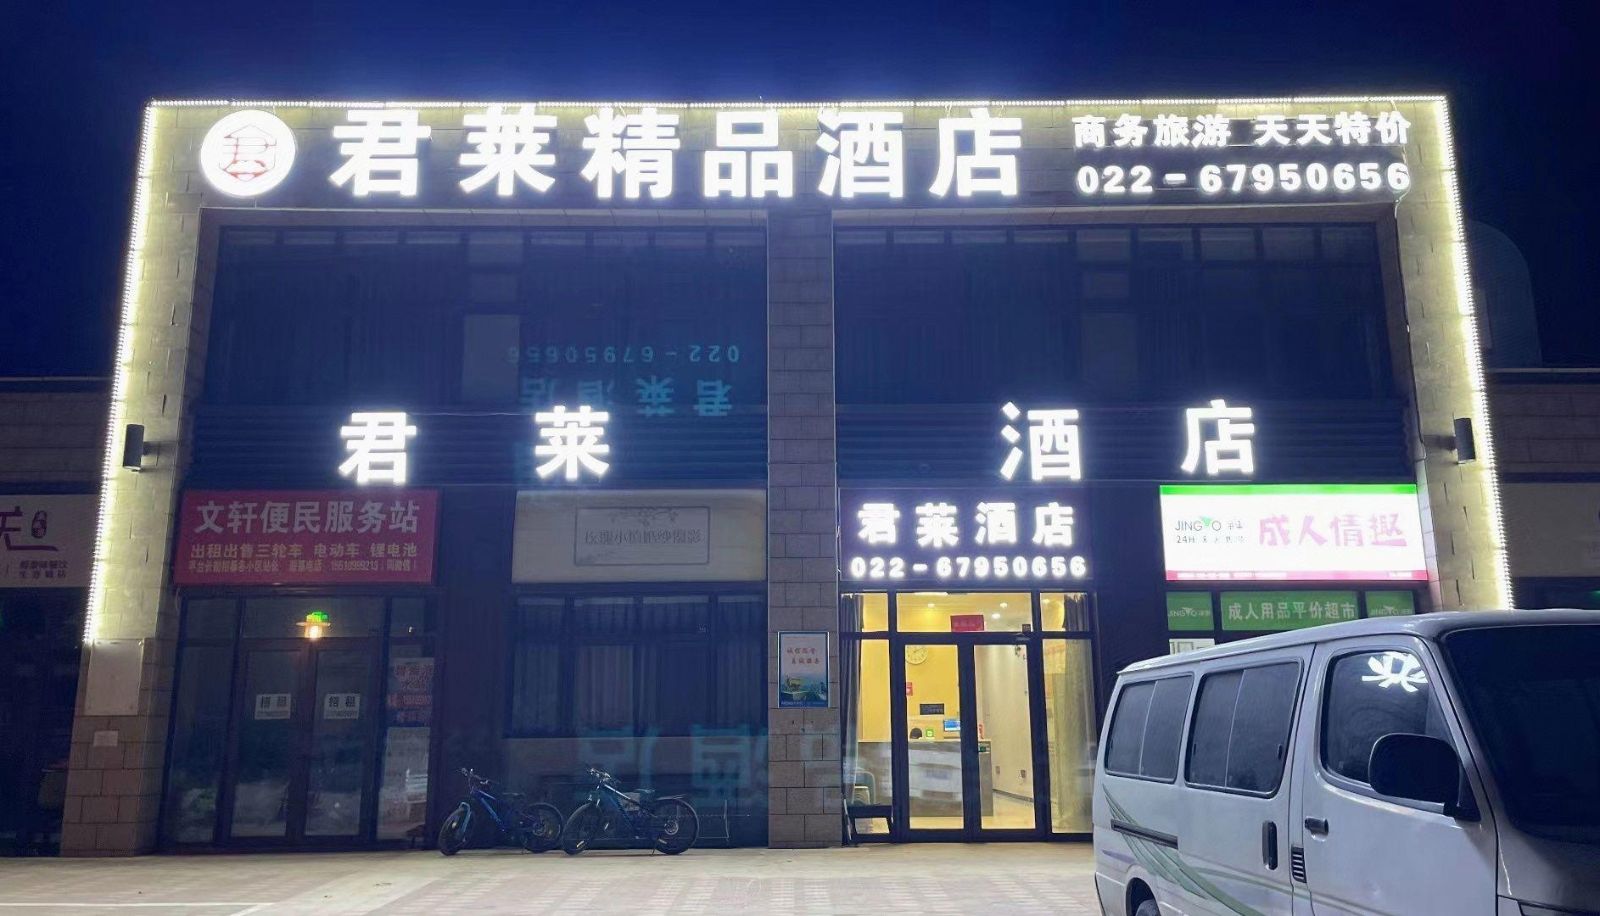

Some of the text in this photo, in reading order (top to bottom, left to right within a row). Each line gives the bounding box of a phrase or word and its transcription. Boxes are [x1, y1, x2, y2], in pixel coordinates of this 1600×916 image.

[1073, 112, 1411, 149] 商务旅游 天天特价
[331, 104, 1023, 199] 君莱精品酒店
[1077, 162, 1411, 195] 022-67950656
[194, 500, 420, 535] 文轩便民服务站
[858, 502, 1075, 548] 君莱酒店
[1258, 513, 1409, 548] 成人情趣
[190, 542, 417, 559] 出租出售三轮车 电动车 锂电池
[851, 556, 1087, 578] 022-67950656
[1228, 601, 1356, 620] 成人用品平价超市
